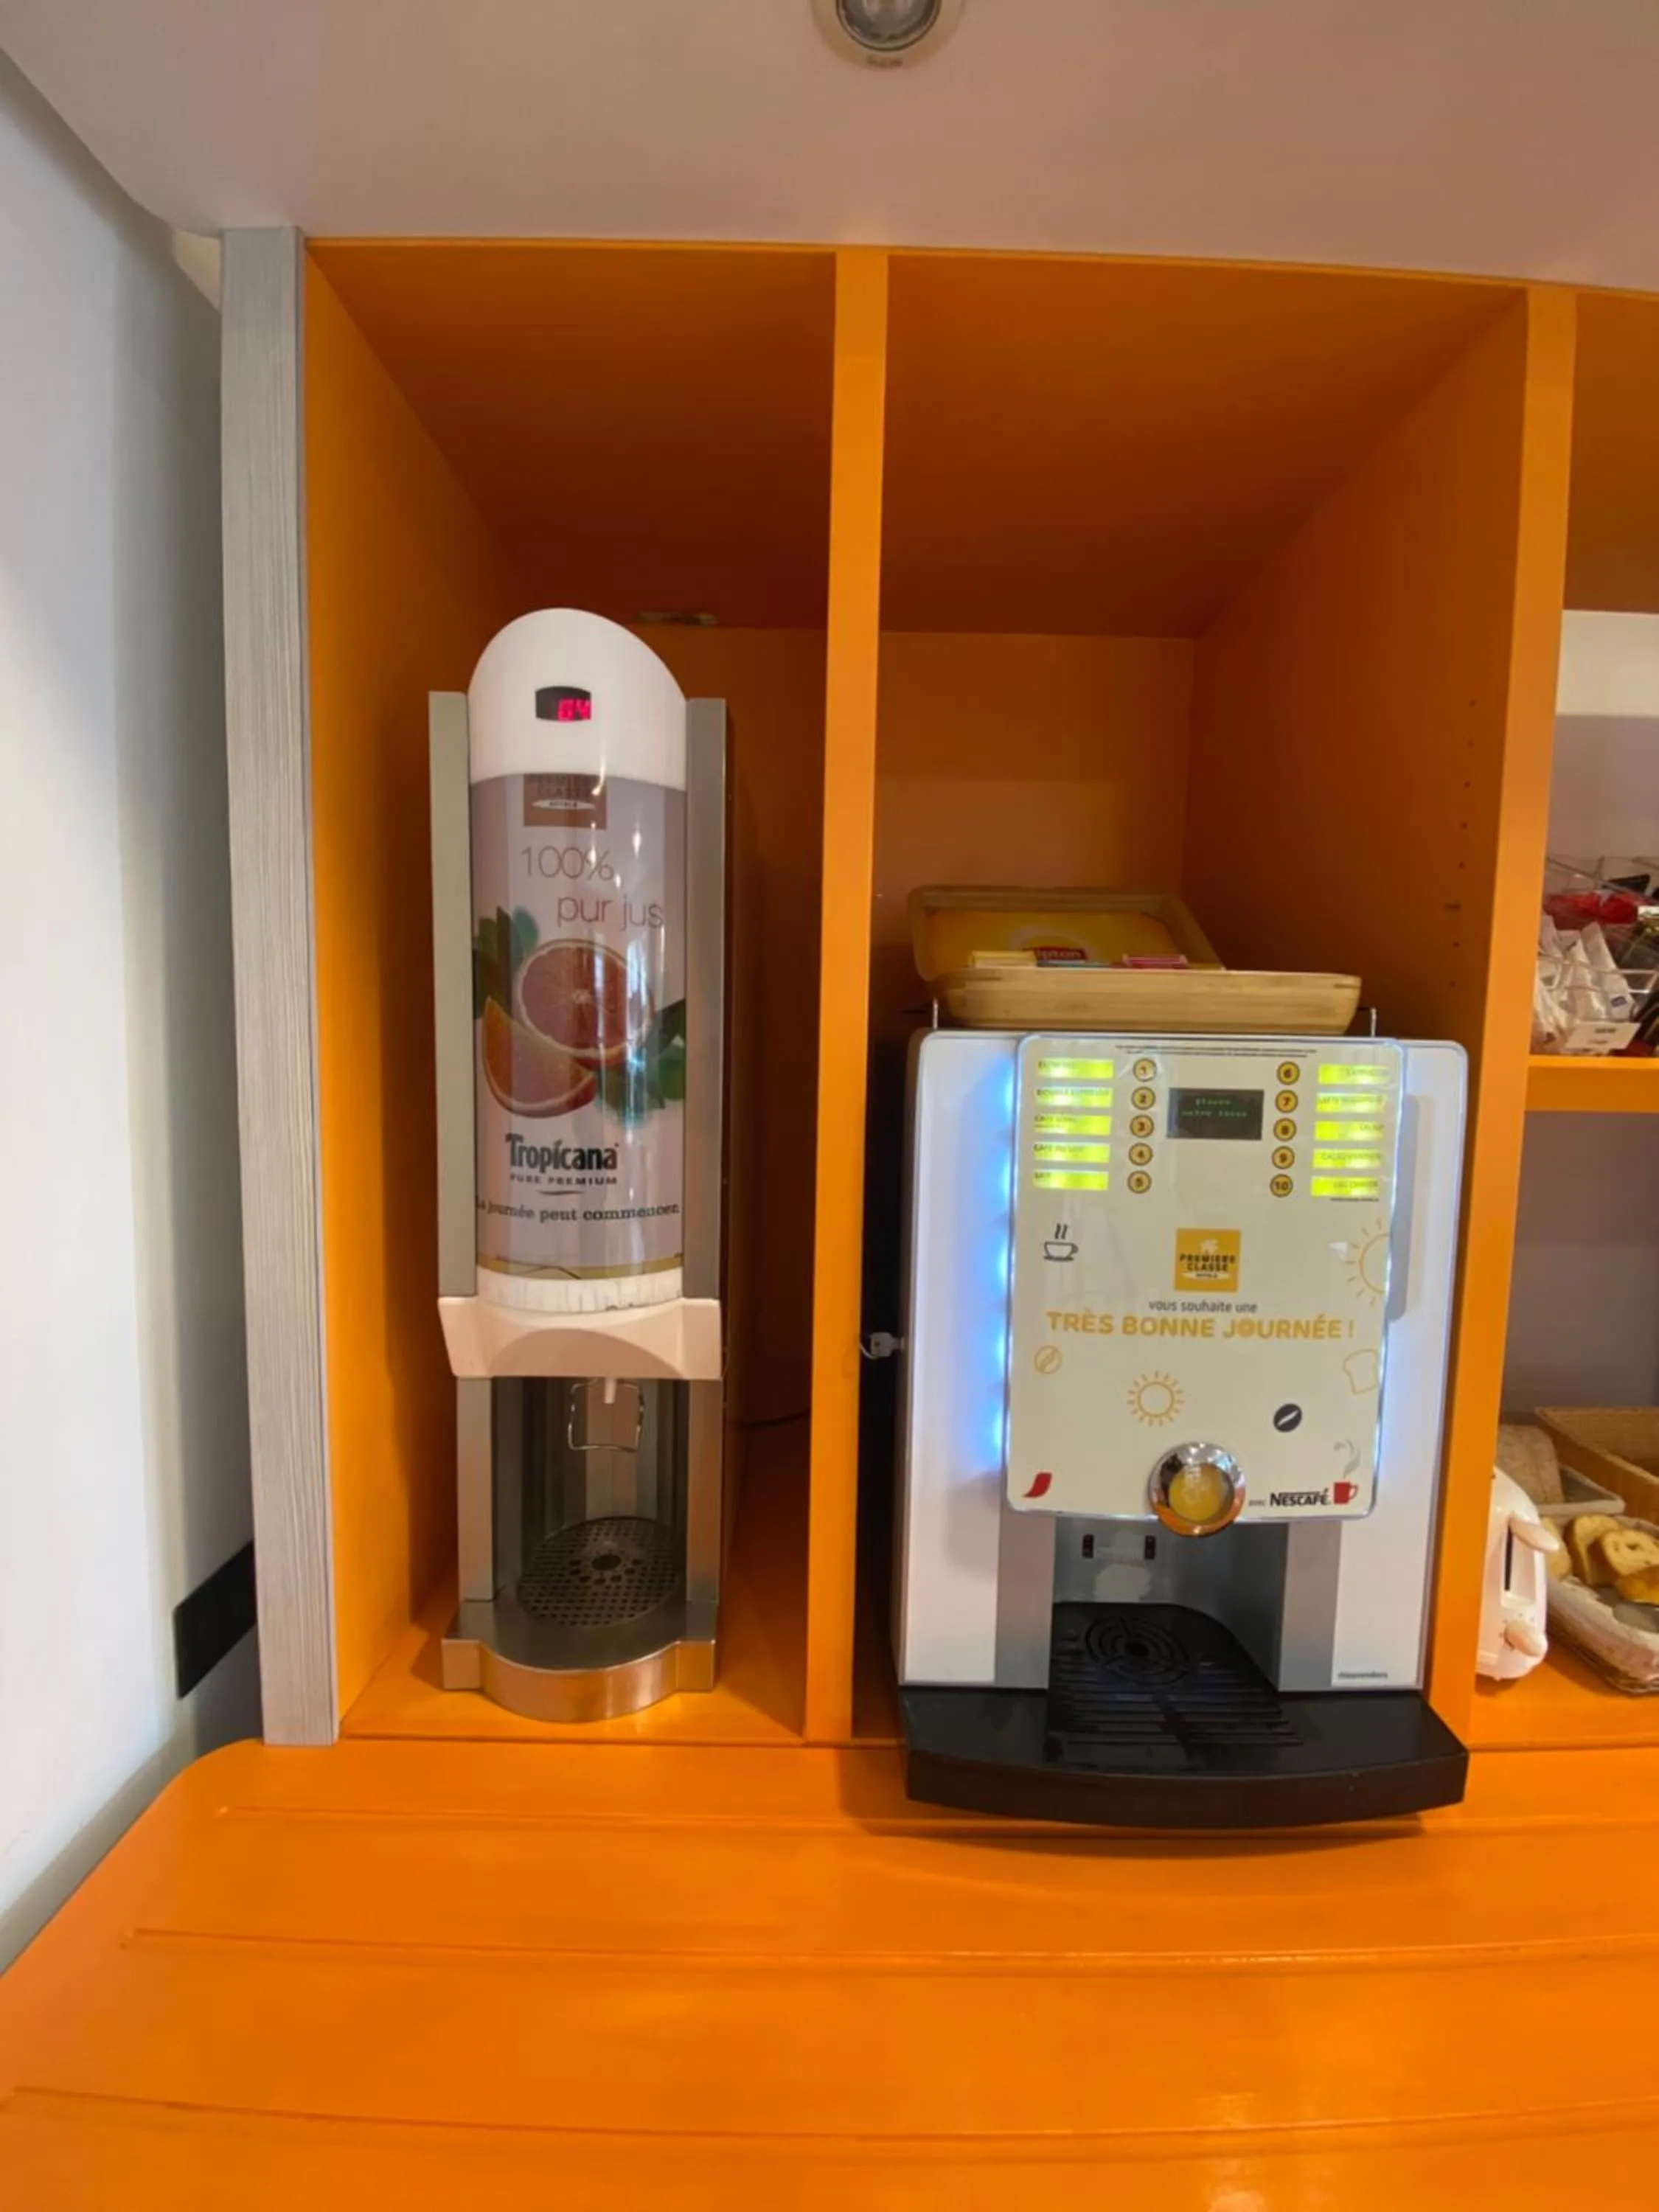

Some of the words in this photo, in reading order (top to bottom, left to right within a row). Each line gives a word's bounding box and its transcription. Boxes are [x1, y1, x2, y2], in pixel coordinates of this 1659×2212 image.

[521, 845, 615, 881] 100%
[557, 895, 613, 927] pur
[619, 894, 664, 929] jus
[505, 1133, 618, 1173] Tropicana
[510, 1173, 541, 1183] PURE
[548, 1177, 617, 1186] PREMIUM
[540, 1208, 578, 1223] peut
[1187, 1262, 1228, 1272] CLASSE
[1149, 1301, 1177, 1312] vous
[1180, 1299, 1232, 1313] souhaite
[1235, 1302, 1257, 1313] une
[1046, 1307, 1114, 1335] TRÈS
[1121, 1315, 1215, 1338] BONNE
[1222, 1314, 1342, 1340] JOURNÉE
